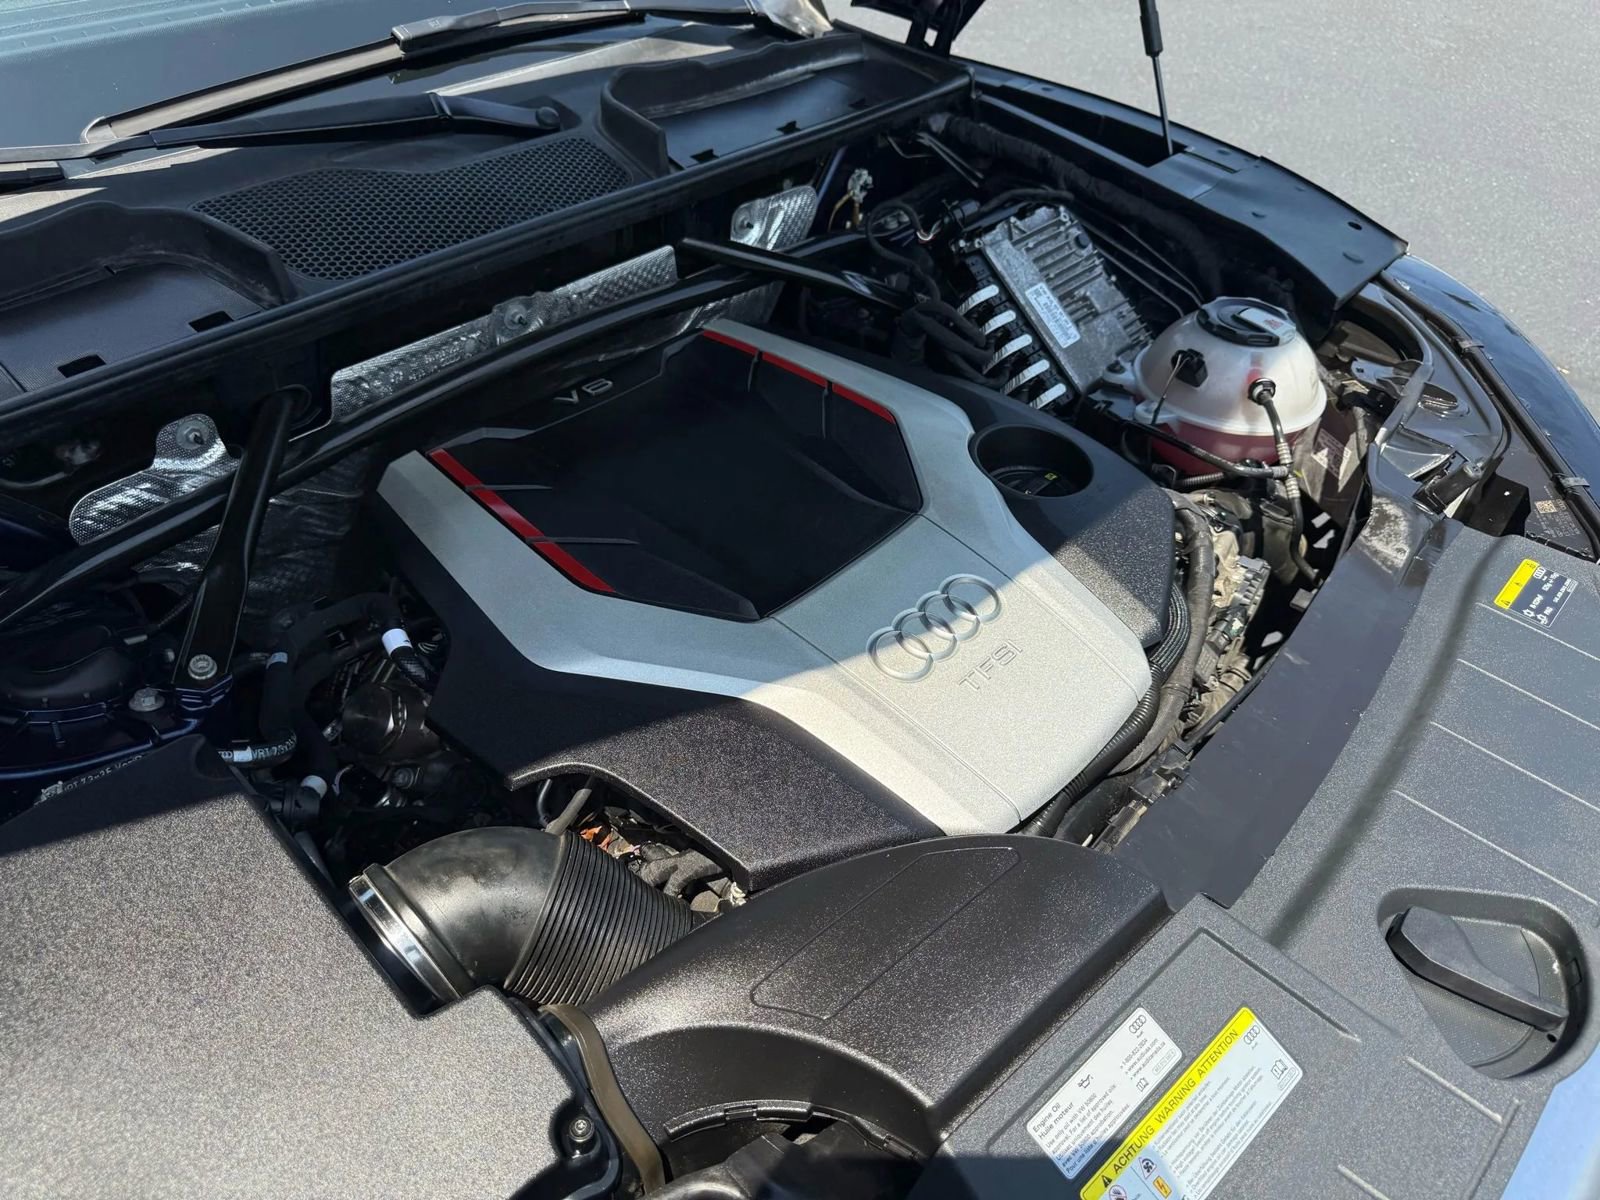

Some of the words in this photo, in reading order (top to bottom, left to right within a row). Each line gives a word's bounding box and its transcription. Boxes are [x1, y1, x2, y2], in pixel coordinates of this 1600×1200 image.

[959, 639, 1023, 691] TFSI
[1032, 1110, 1053, 1133] Engine
[1051, 1101, 1061, 1113] Oil
[1038, 1122, 1054, 1140] Huile
[1052, 1101, 1074, 1125] moteur
[1110, 1123, 1155, 1175] ACHTUNG
[1154, 1076, 1196, 1125] WARNING
[1194, 1027, 1239, 1079] ATTENTION
